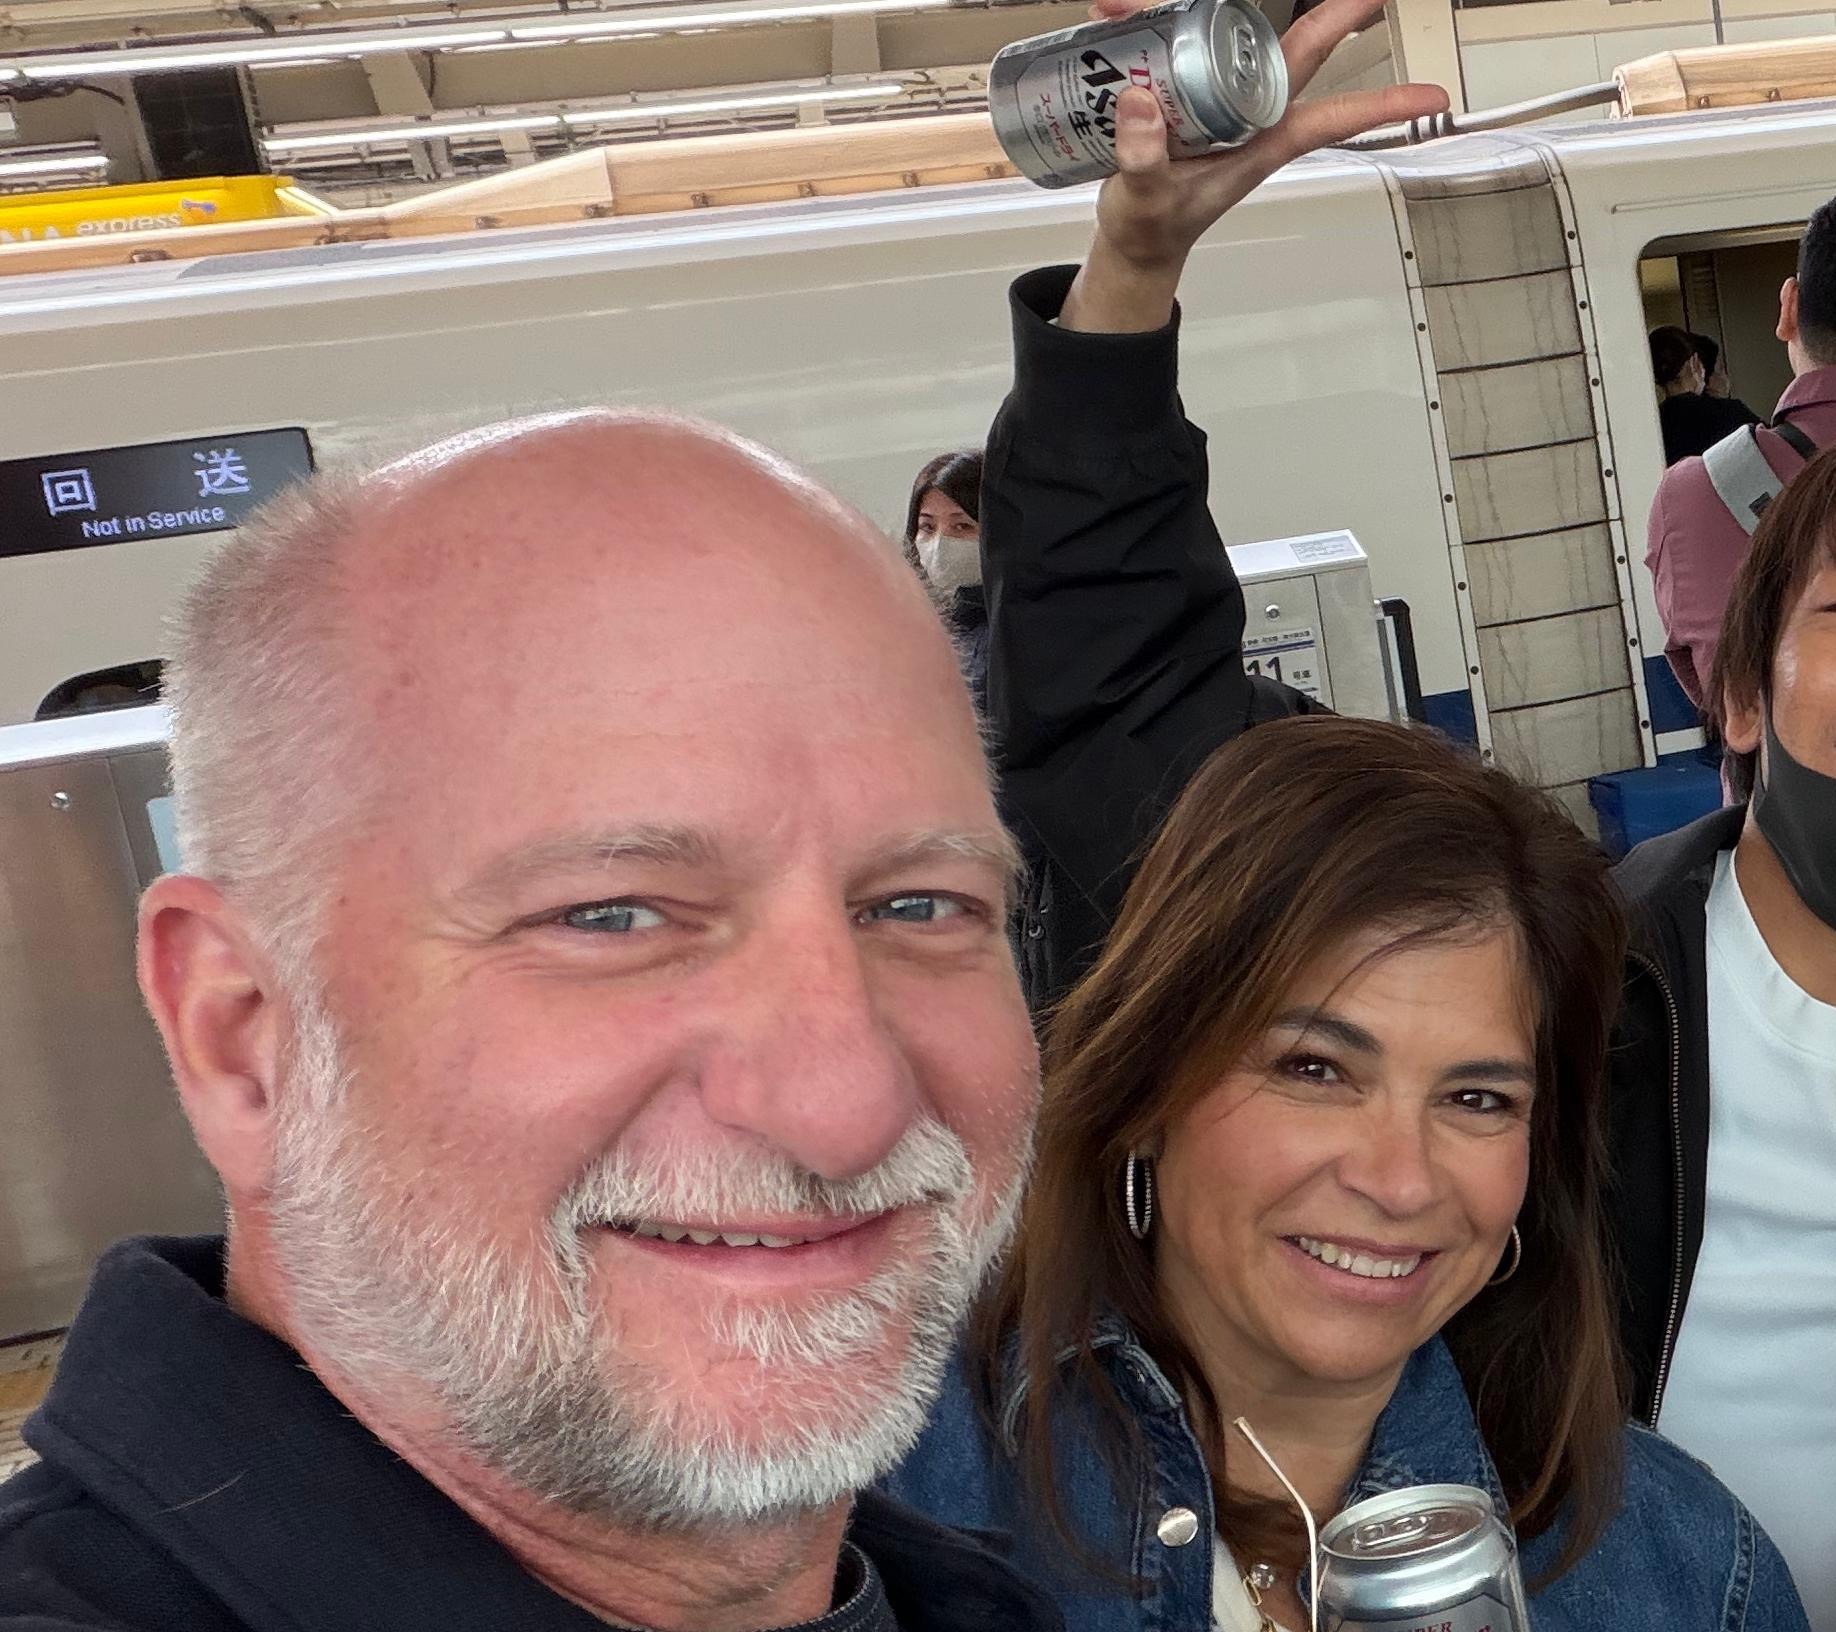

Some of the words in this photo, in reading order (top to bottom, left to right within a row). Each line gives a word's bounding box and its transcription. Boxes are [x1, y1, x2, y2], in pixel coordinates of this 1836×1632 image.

[77, 214, 182, 236] express
[80, 517, 121, 539] Not
[125, 515, 146, 535] in
[148, 506, 225, 531] Service
